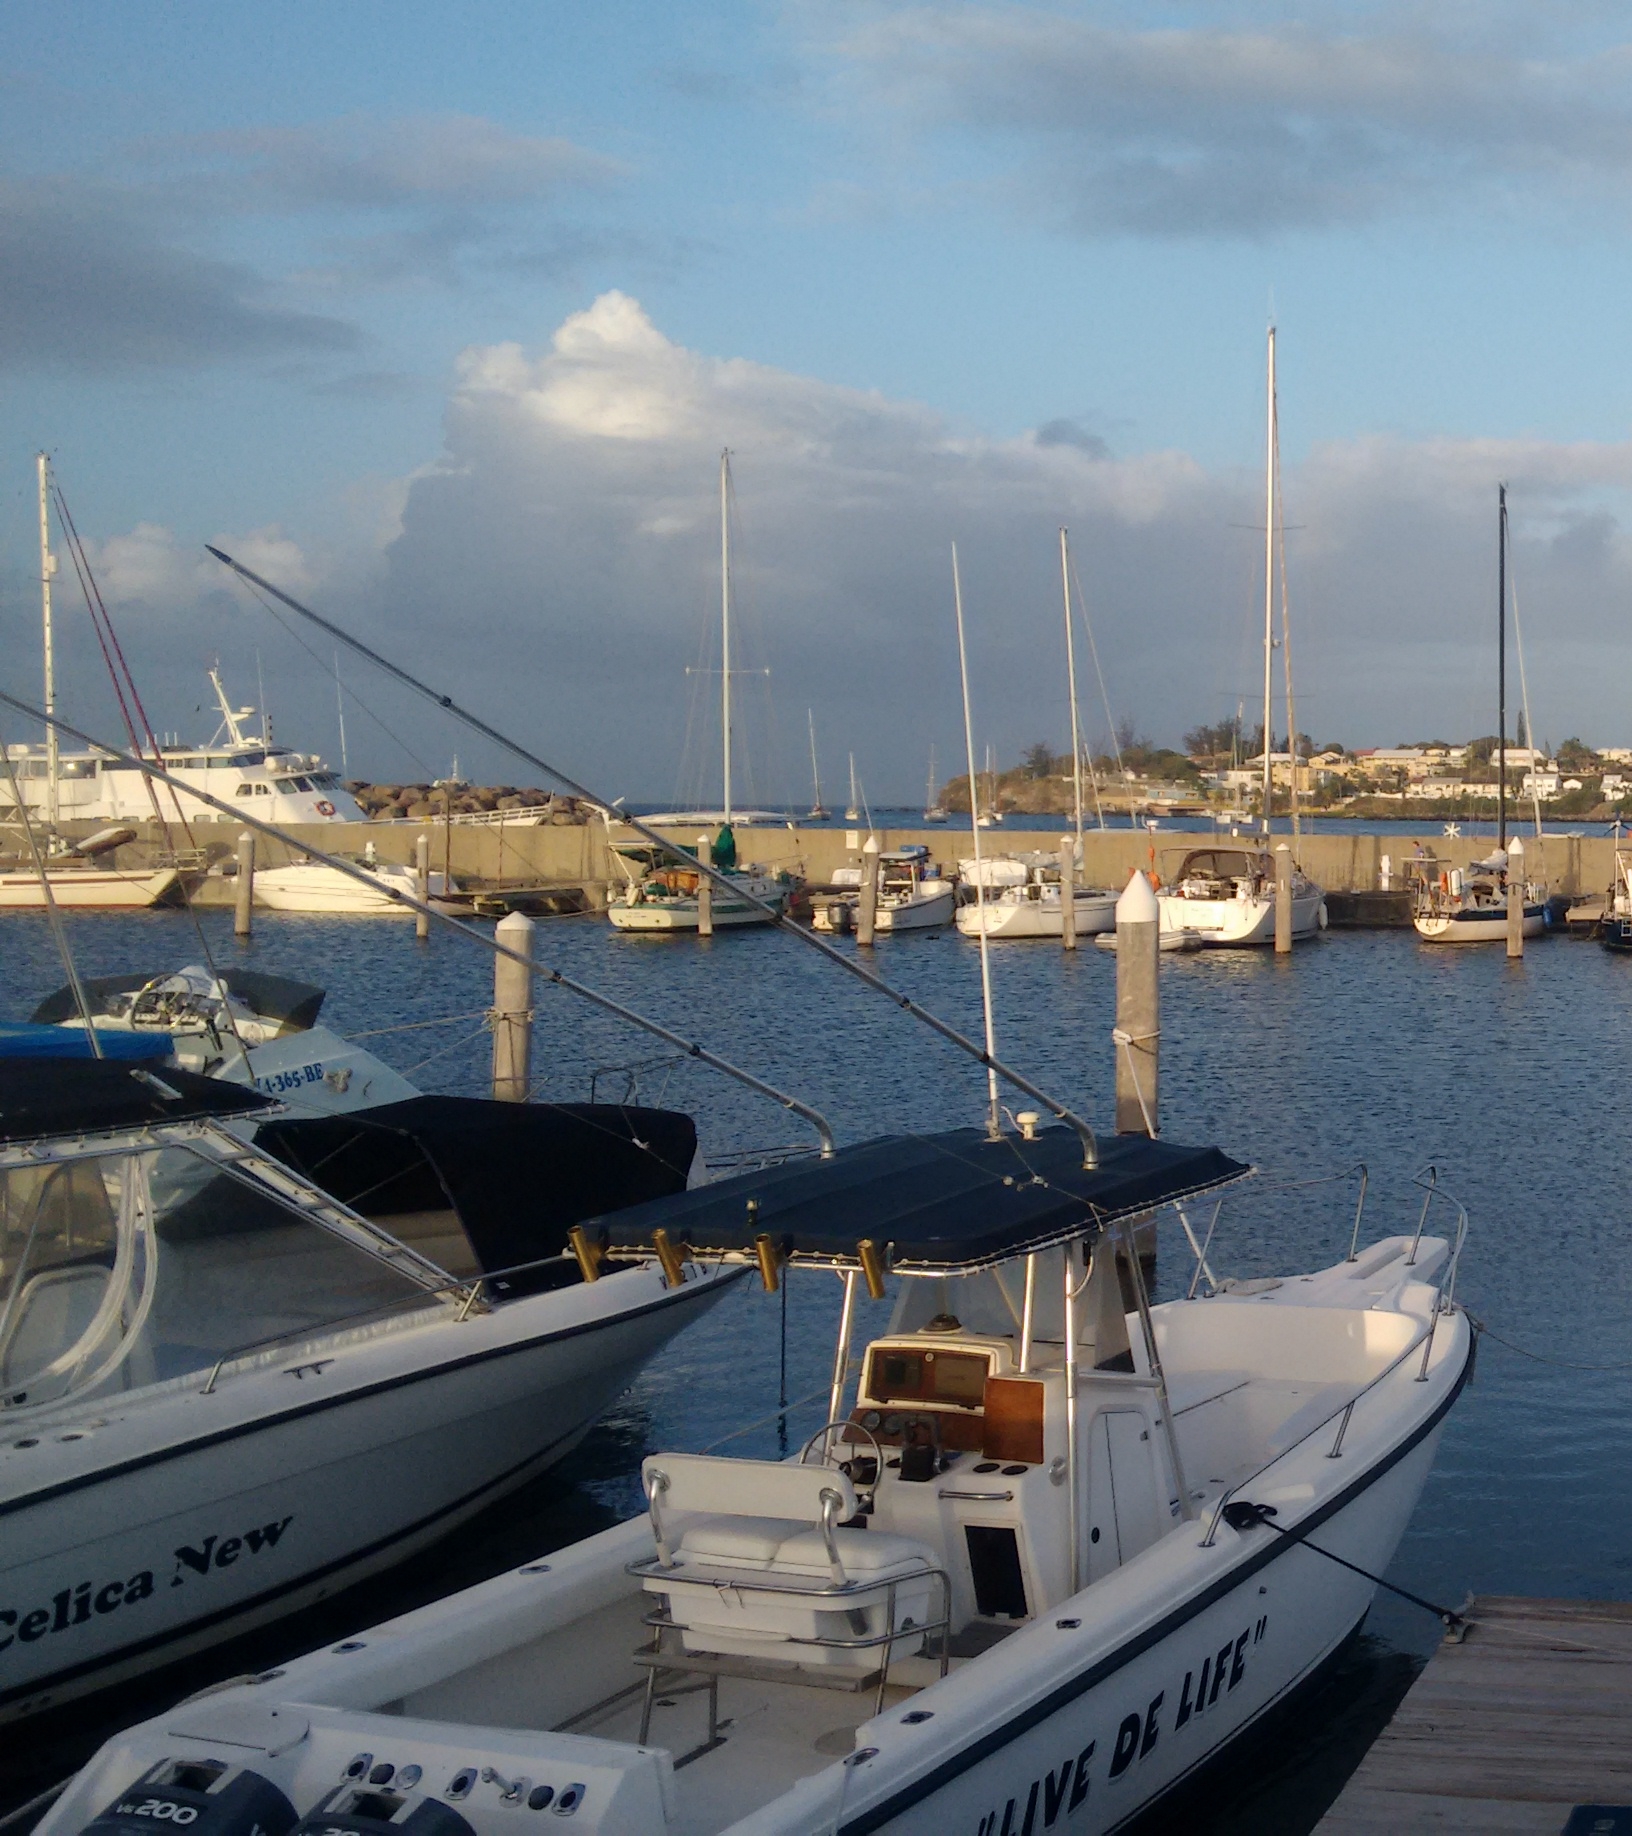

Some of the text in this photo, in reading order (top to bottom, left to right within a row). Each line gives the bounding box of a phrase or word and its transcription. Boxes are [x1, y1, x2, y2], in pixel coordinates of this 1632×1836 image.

[170, 1515, 294, 1588] New
[1108, 1690, 1166, 1778] DE
[134, 1798, 199, 1826] 200
